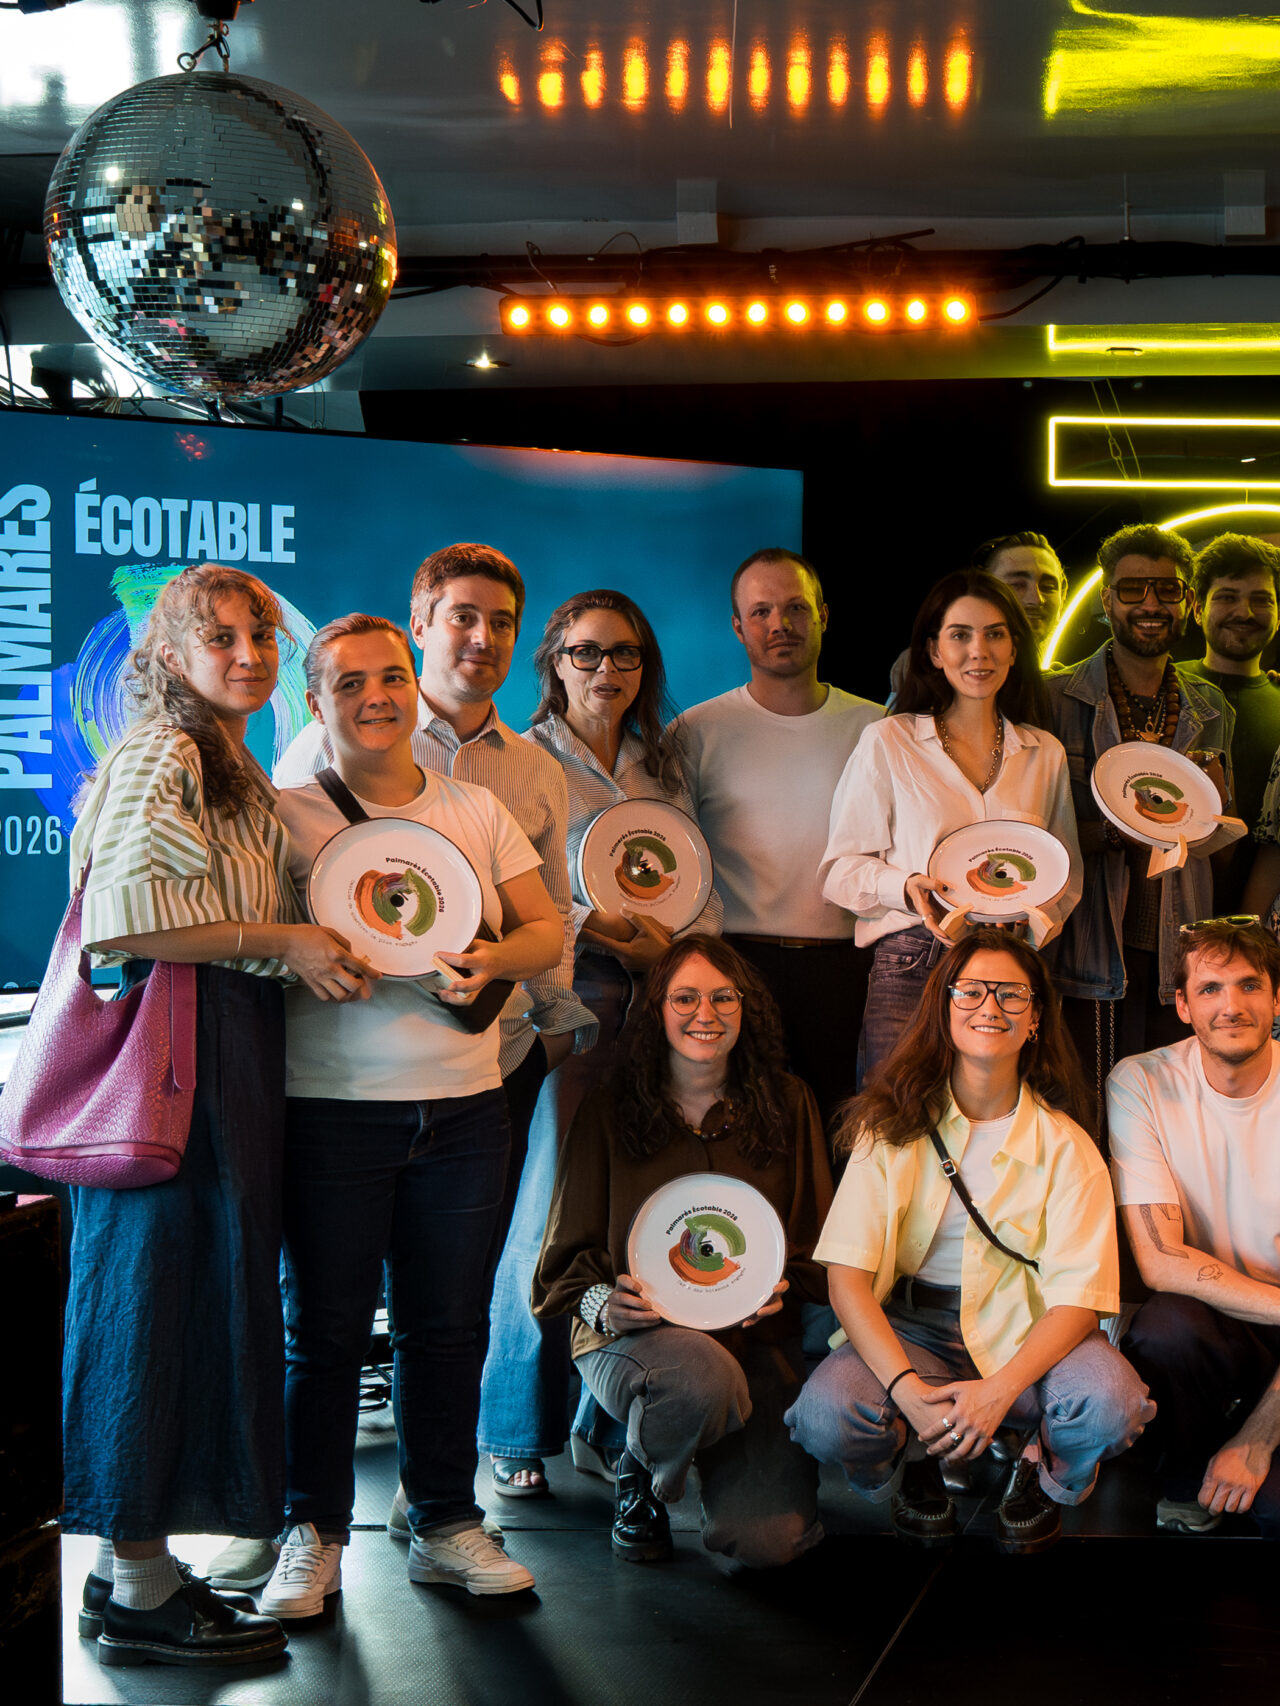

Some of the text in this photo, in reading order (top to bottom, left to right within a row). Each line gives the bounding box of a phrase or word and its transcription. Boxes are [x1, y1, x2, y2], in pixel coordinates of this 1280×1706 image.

[75, 477, 296, 564] ÉCOTABLE
[0, 815, 62, 856] 026
[609, 833, 628, 857] Palmarès
[385, 857, 421, 870] Palmarès
[421, 865, 442, 896] Écotable
[666, 1205, 738, 1235] Palmarès Écotable 2026
